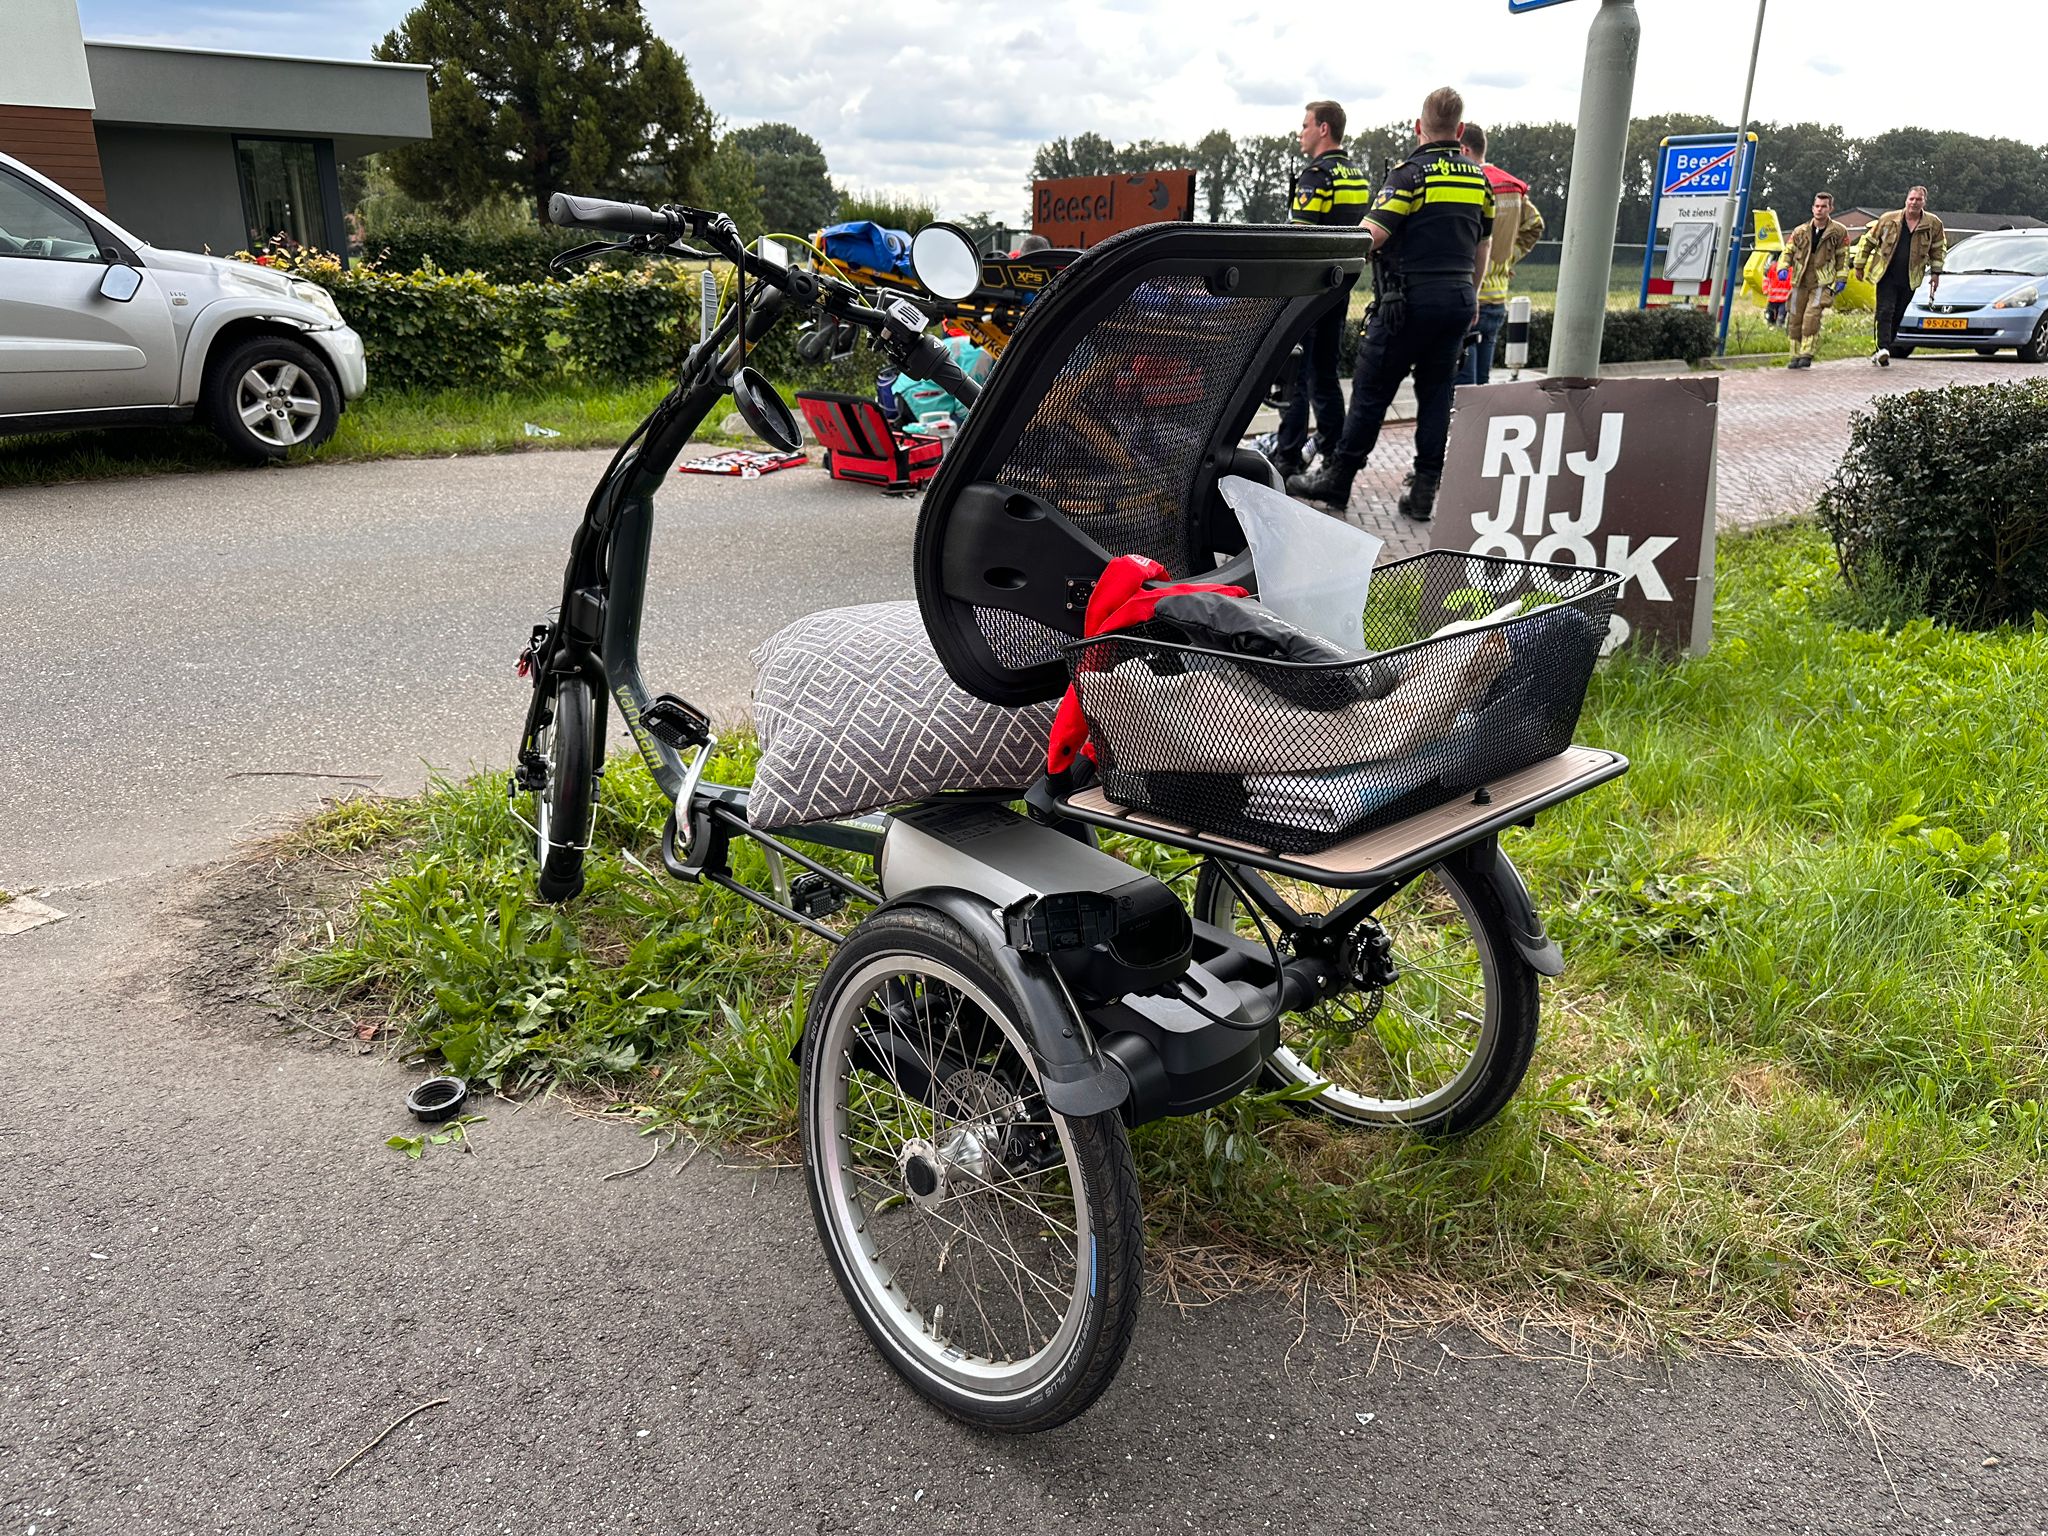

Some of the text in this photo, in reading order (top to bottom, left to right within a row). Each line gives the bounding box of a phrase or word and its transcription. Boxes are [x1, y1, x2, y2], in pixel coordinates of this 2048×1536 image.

[1677, 152, 1735, 169] Beesel
[1679, 170, 1727, 187] Bezel
[1037, 180, 1116, 225] Beesel
[1677, 206, 1718, 218] Tot ziens!
[1017, 271, 1043, 283] XPS
[1925, 319, 1965, 328] 95-JZ-GT
[1481, 412, 1625, 478] RIJ
[1470, 473, 1607, 537] JIJ
[1465, 532, 1680, 603] OOK
[1044, 1297, 1095, 1399] MARATHON PLUS
